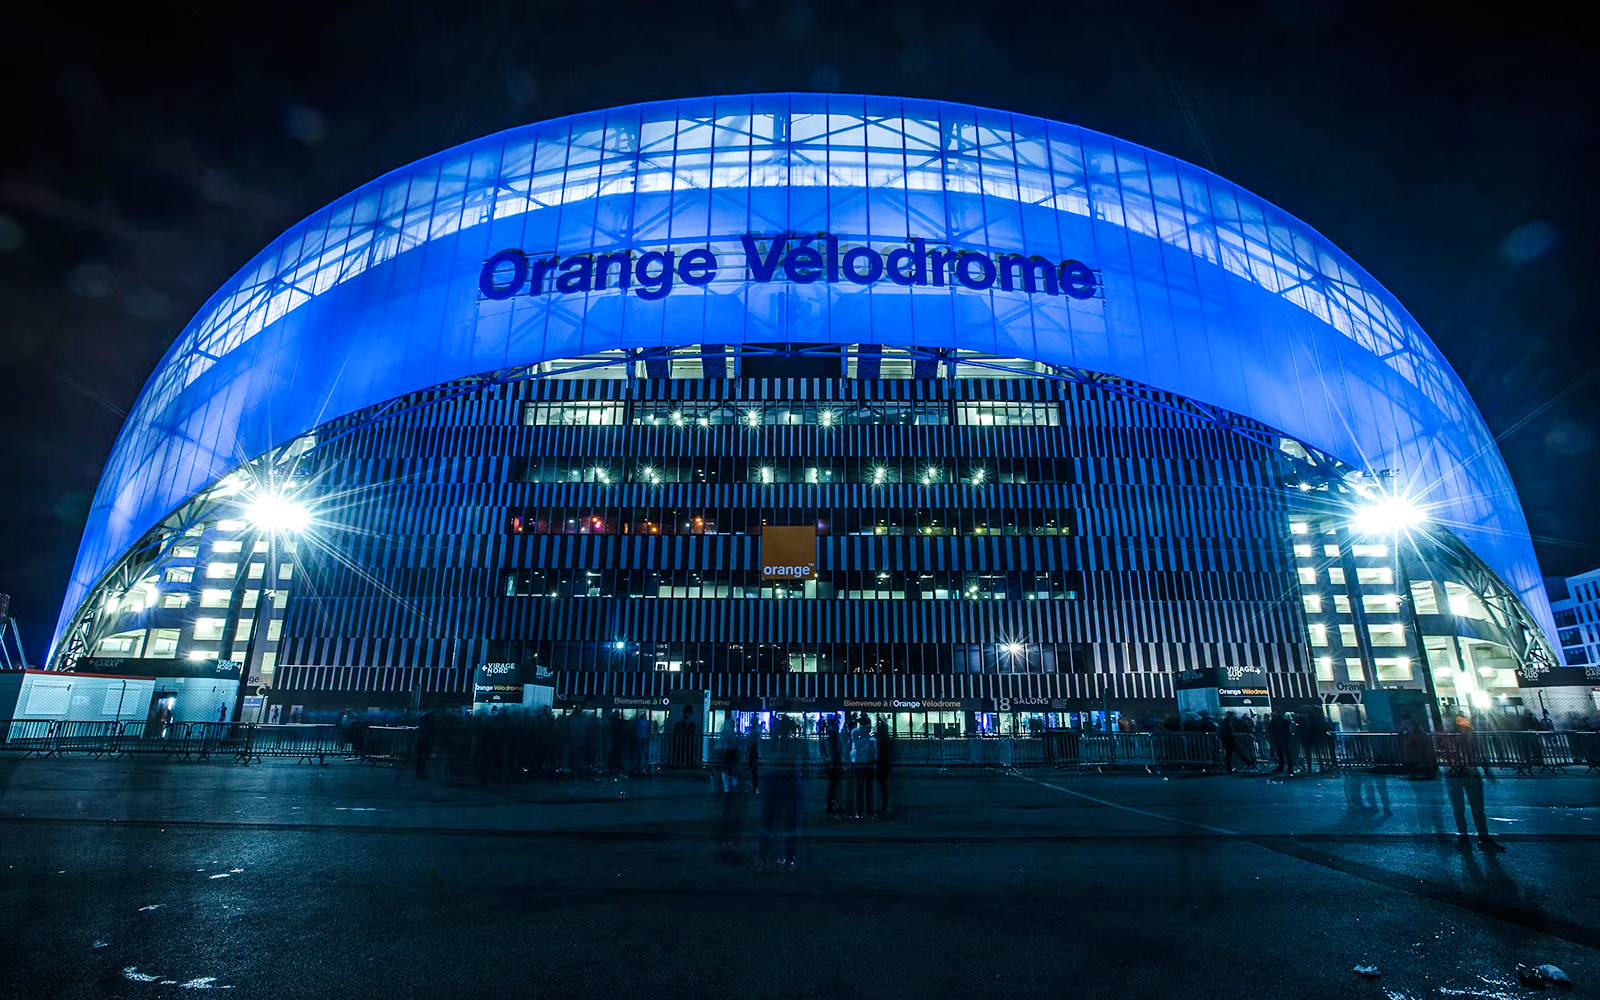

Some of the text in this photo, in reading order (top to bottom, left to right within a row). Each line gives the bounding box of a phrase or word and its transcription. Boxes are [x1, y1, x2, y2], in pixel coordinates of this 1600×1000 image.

[479, 231, 1100, 300] Orange Vélodrome
[763, 565, 811, 578] orange
[487, 662, 516, 670] VIRAGE
[1226, 665, 1255, 674] VIRAGE
[1524, 671, 1539, 679] SUD
[614, 697, 651, 705] Bienvenue
[844, 699, 882, 707] Bienvenue
[921, 699, 961, 707] Vélodrome
[991, 697, 1011, 712] 18
[1013, 697, 1049, 705] SALONS
